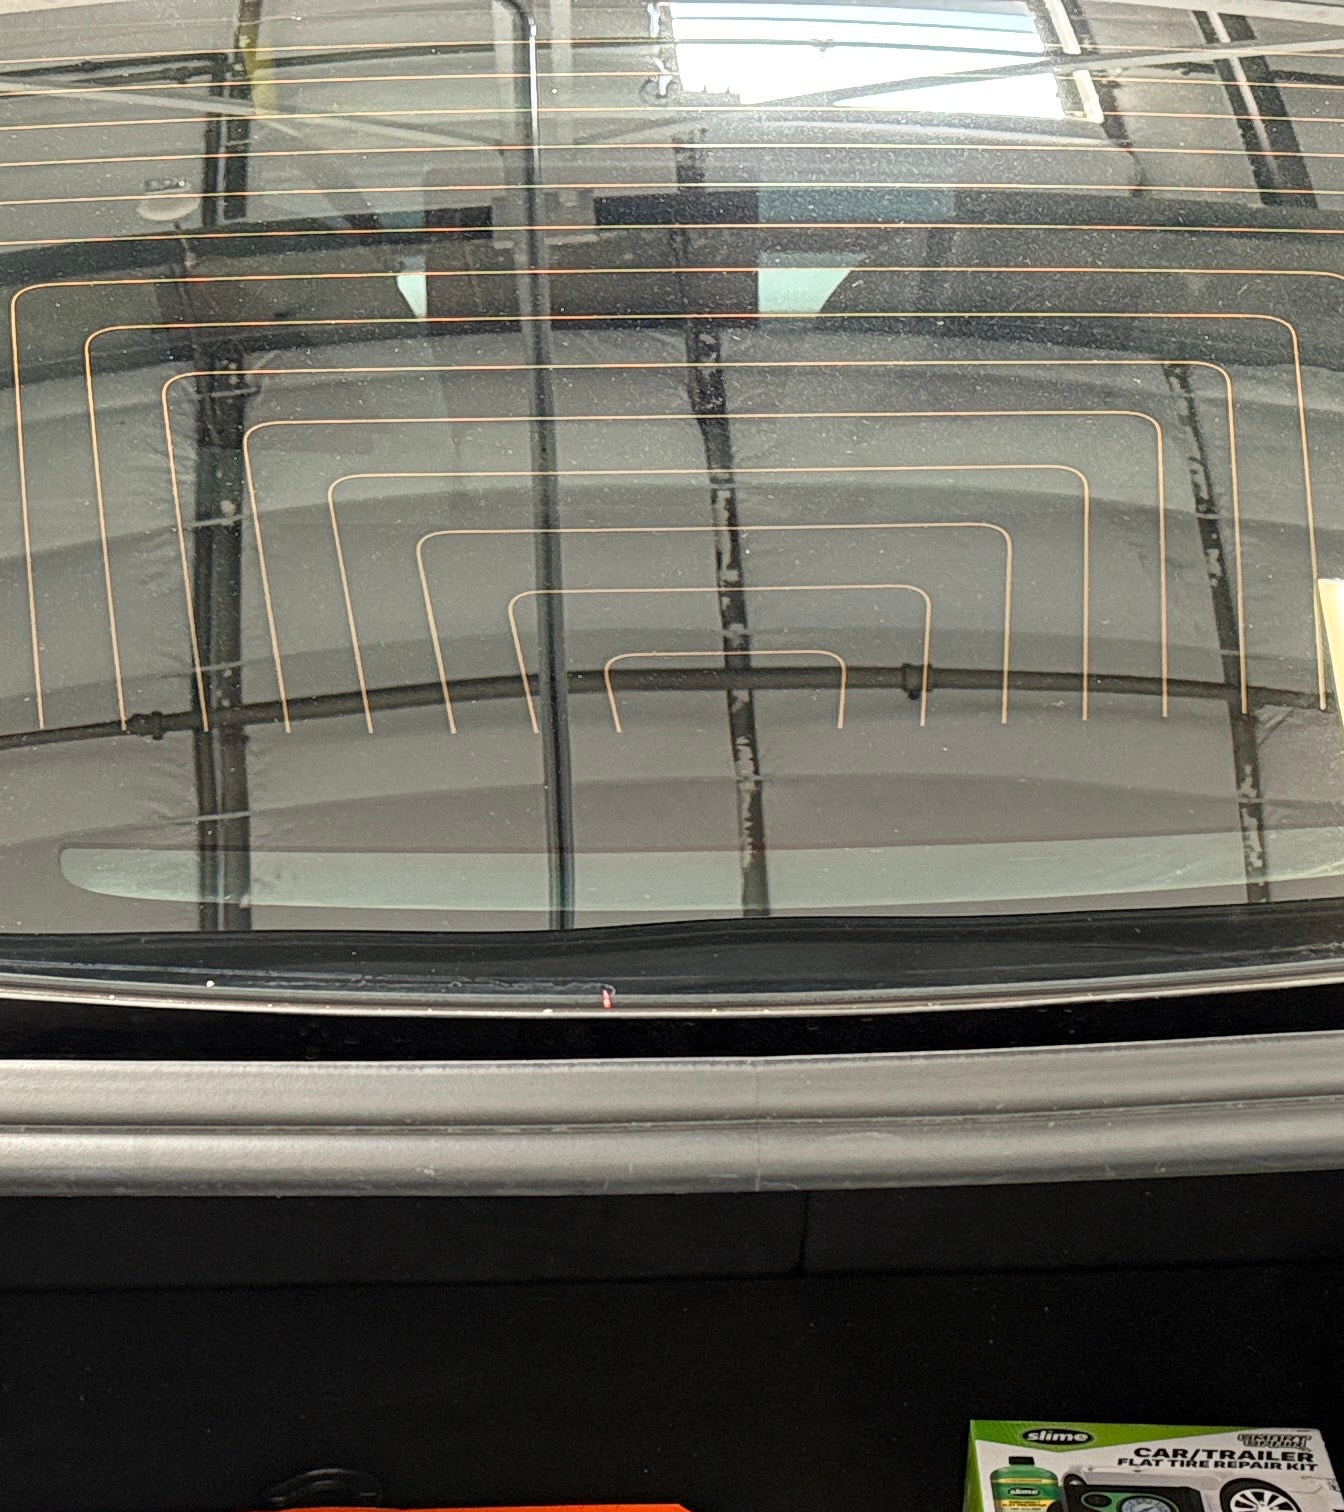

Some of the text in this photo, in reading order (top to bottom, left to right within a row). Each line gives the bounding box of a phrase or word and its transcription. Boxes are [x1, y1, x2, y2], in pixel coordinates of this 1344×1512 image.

[1027, 1430, 1089, 1442] slime
[1133, 1446, 1315, 1463] CAR/TRAILER
[1117, 1457, 1319, 1472] FLAT TIRE REPAIR KIT
